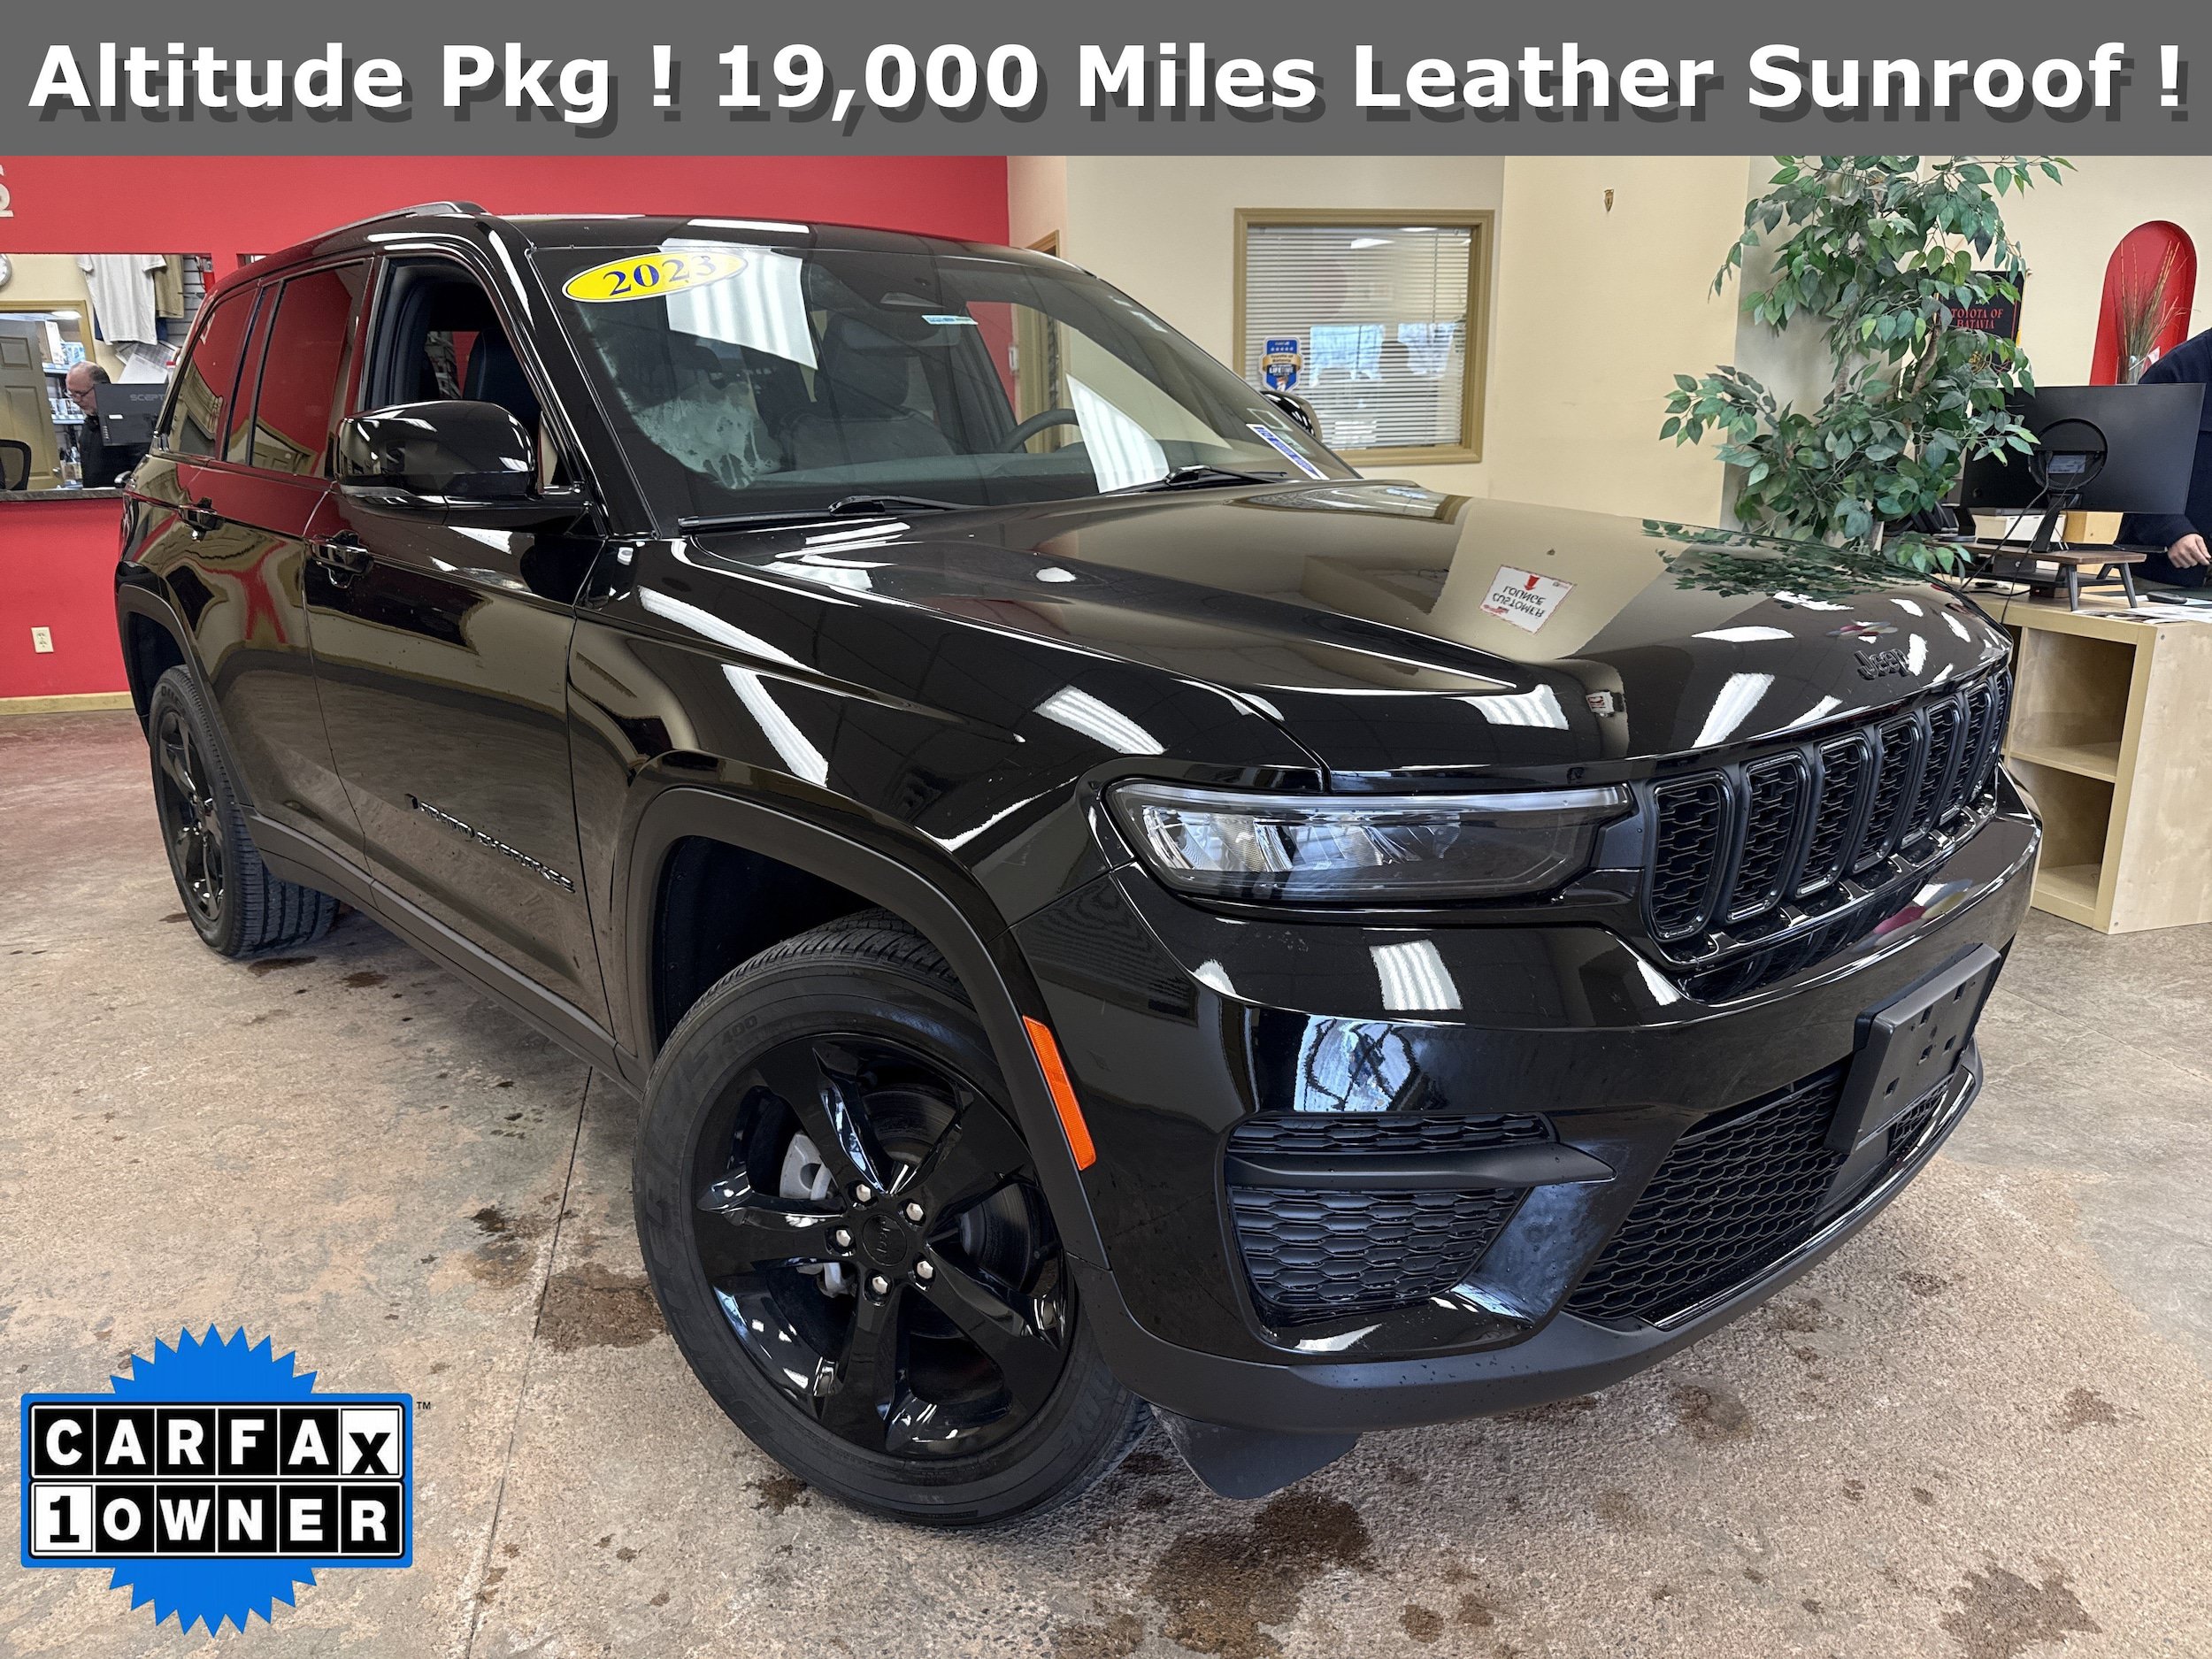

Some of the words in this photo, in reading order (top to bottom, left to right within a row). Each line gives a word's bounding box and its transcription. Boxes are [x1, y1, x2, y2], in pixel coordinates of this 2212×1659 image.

[603, 256, 717, 296] 2023
[1951, 308, 1987, 319] TOYOTA
[1990, 308, 2004, 318] OF
[1956, 319, 1995, 329] BATAVIA
[1854, 648, 1910, 680] Jeep
[721, 1015, 758, 1045] 400
